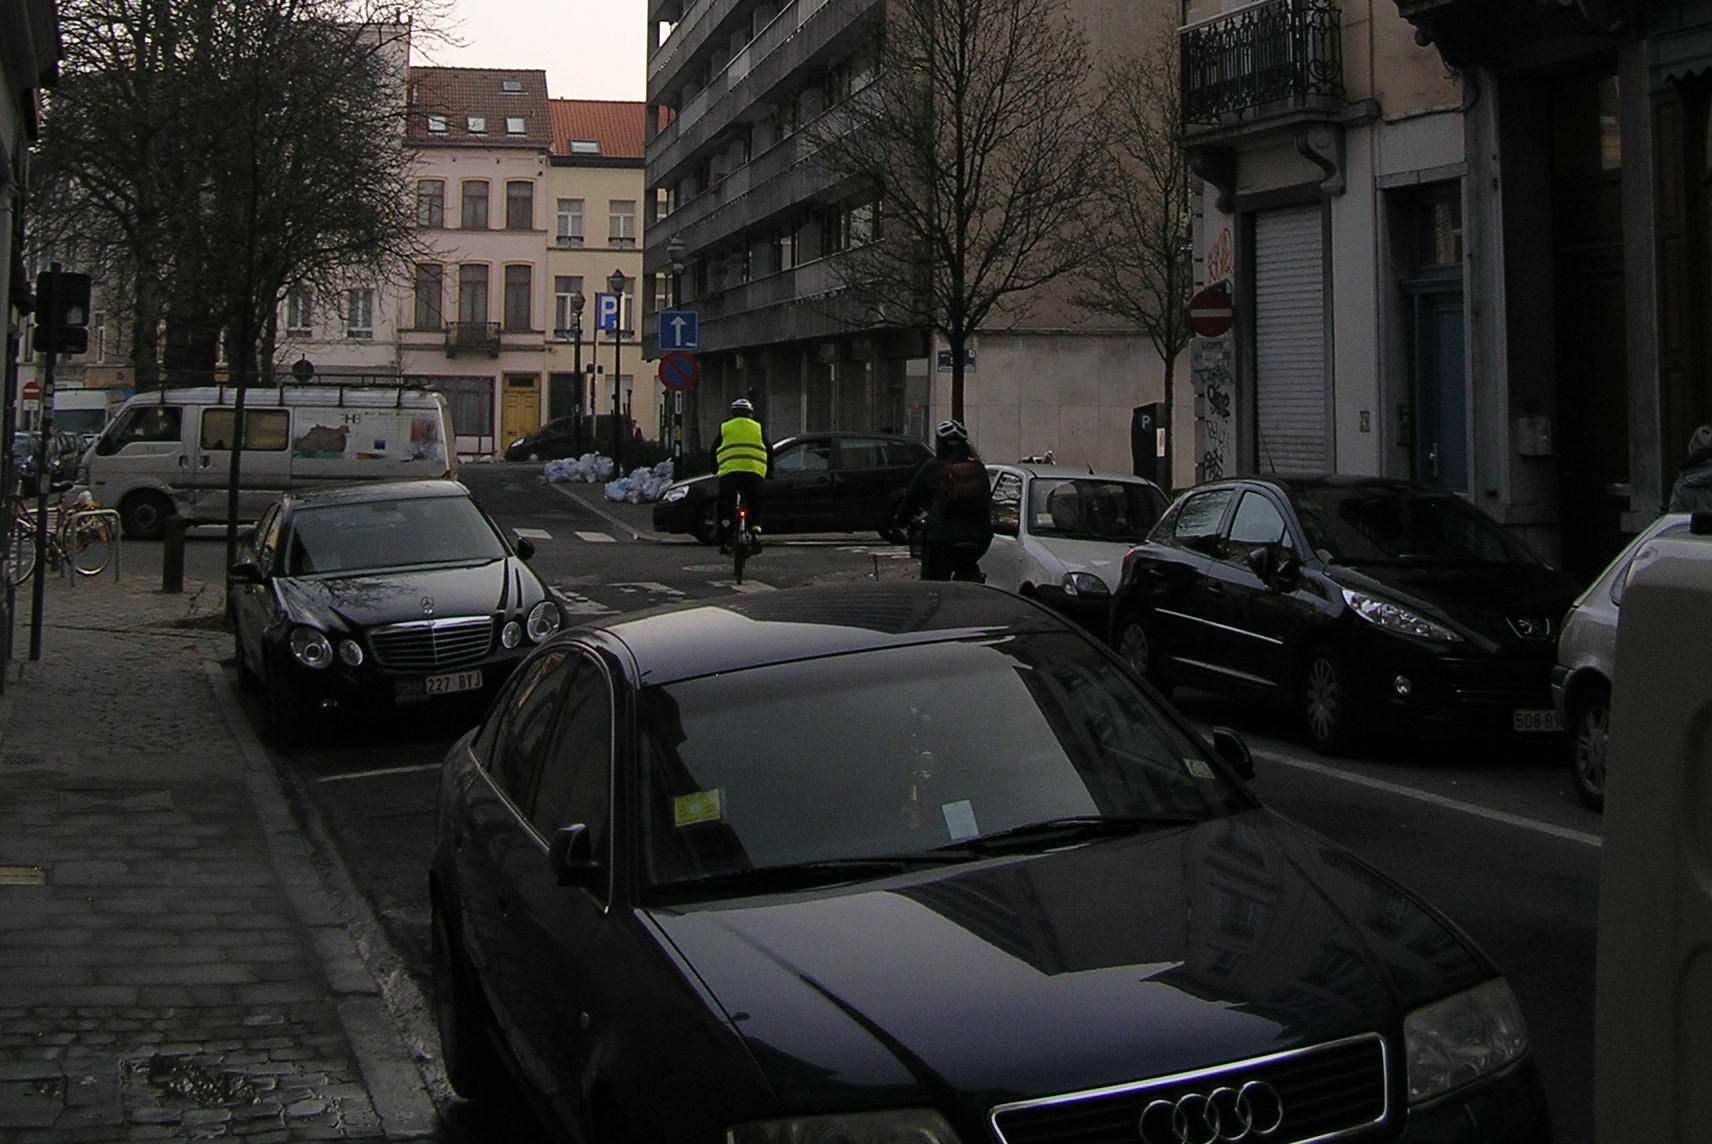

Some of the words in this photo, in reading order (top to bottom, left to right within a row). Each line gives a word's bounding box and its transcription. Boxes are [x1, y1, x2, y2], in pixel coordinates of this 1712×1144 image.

[600, 295, 618, 327] P
[1141, 415, 1151, 430] P
[427, 677, 450, 693] 227
[458, 671, 481, 690] BYJ
